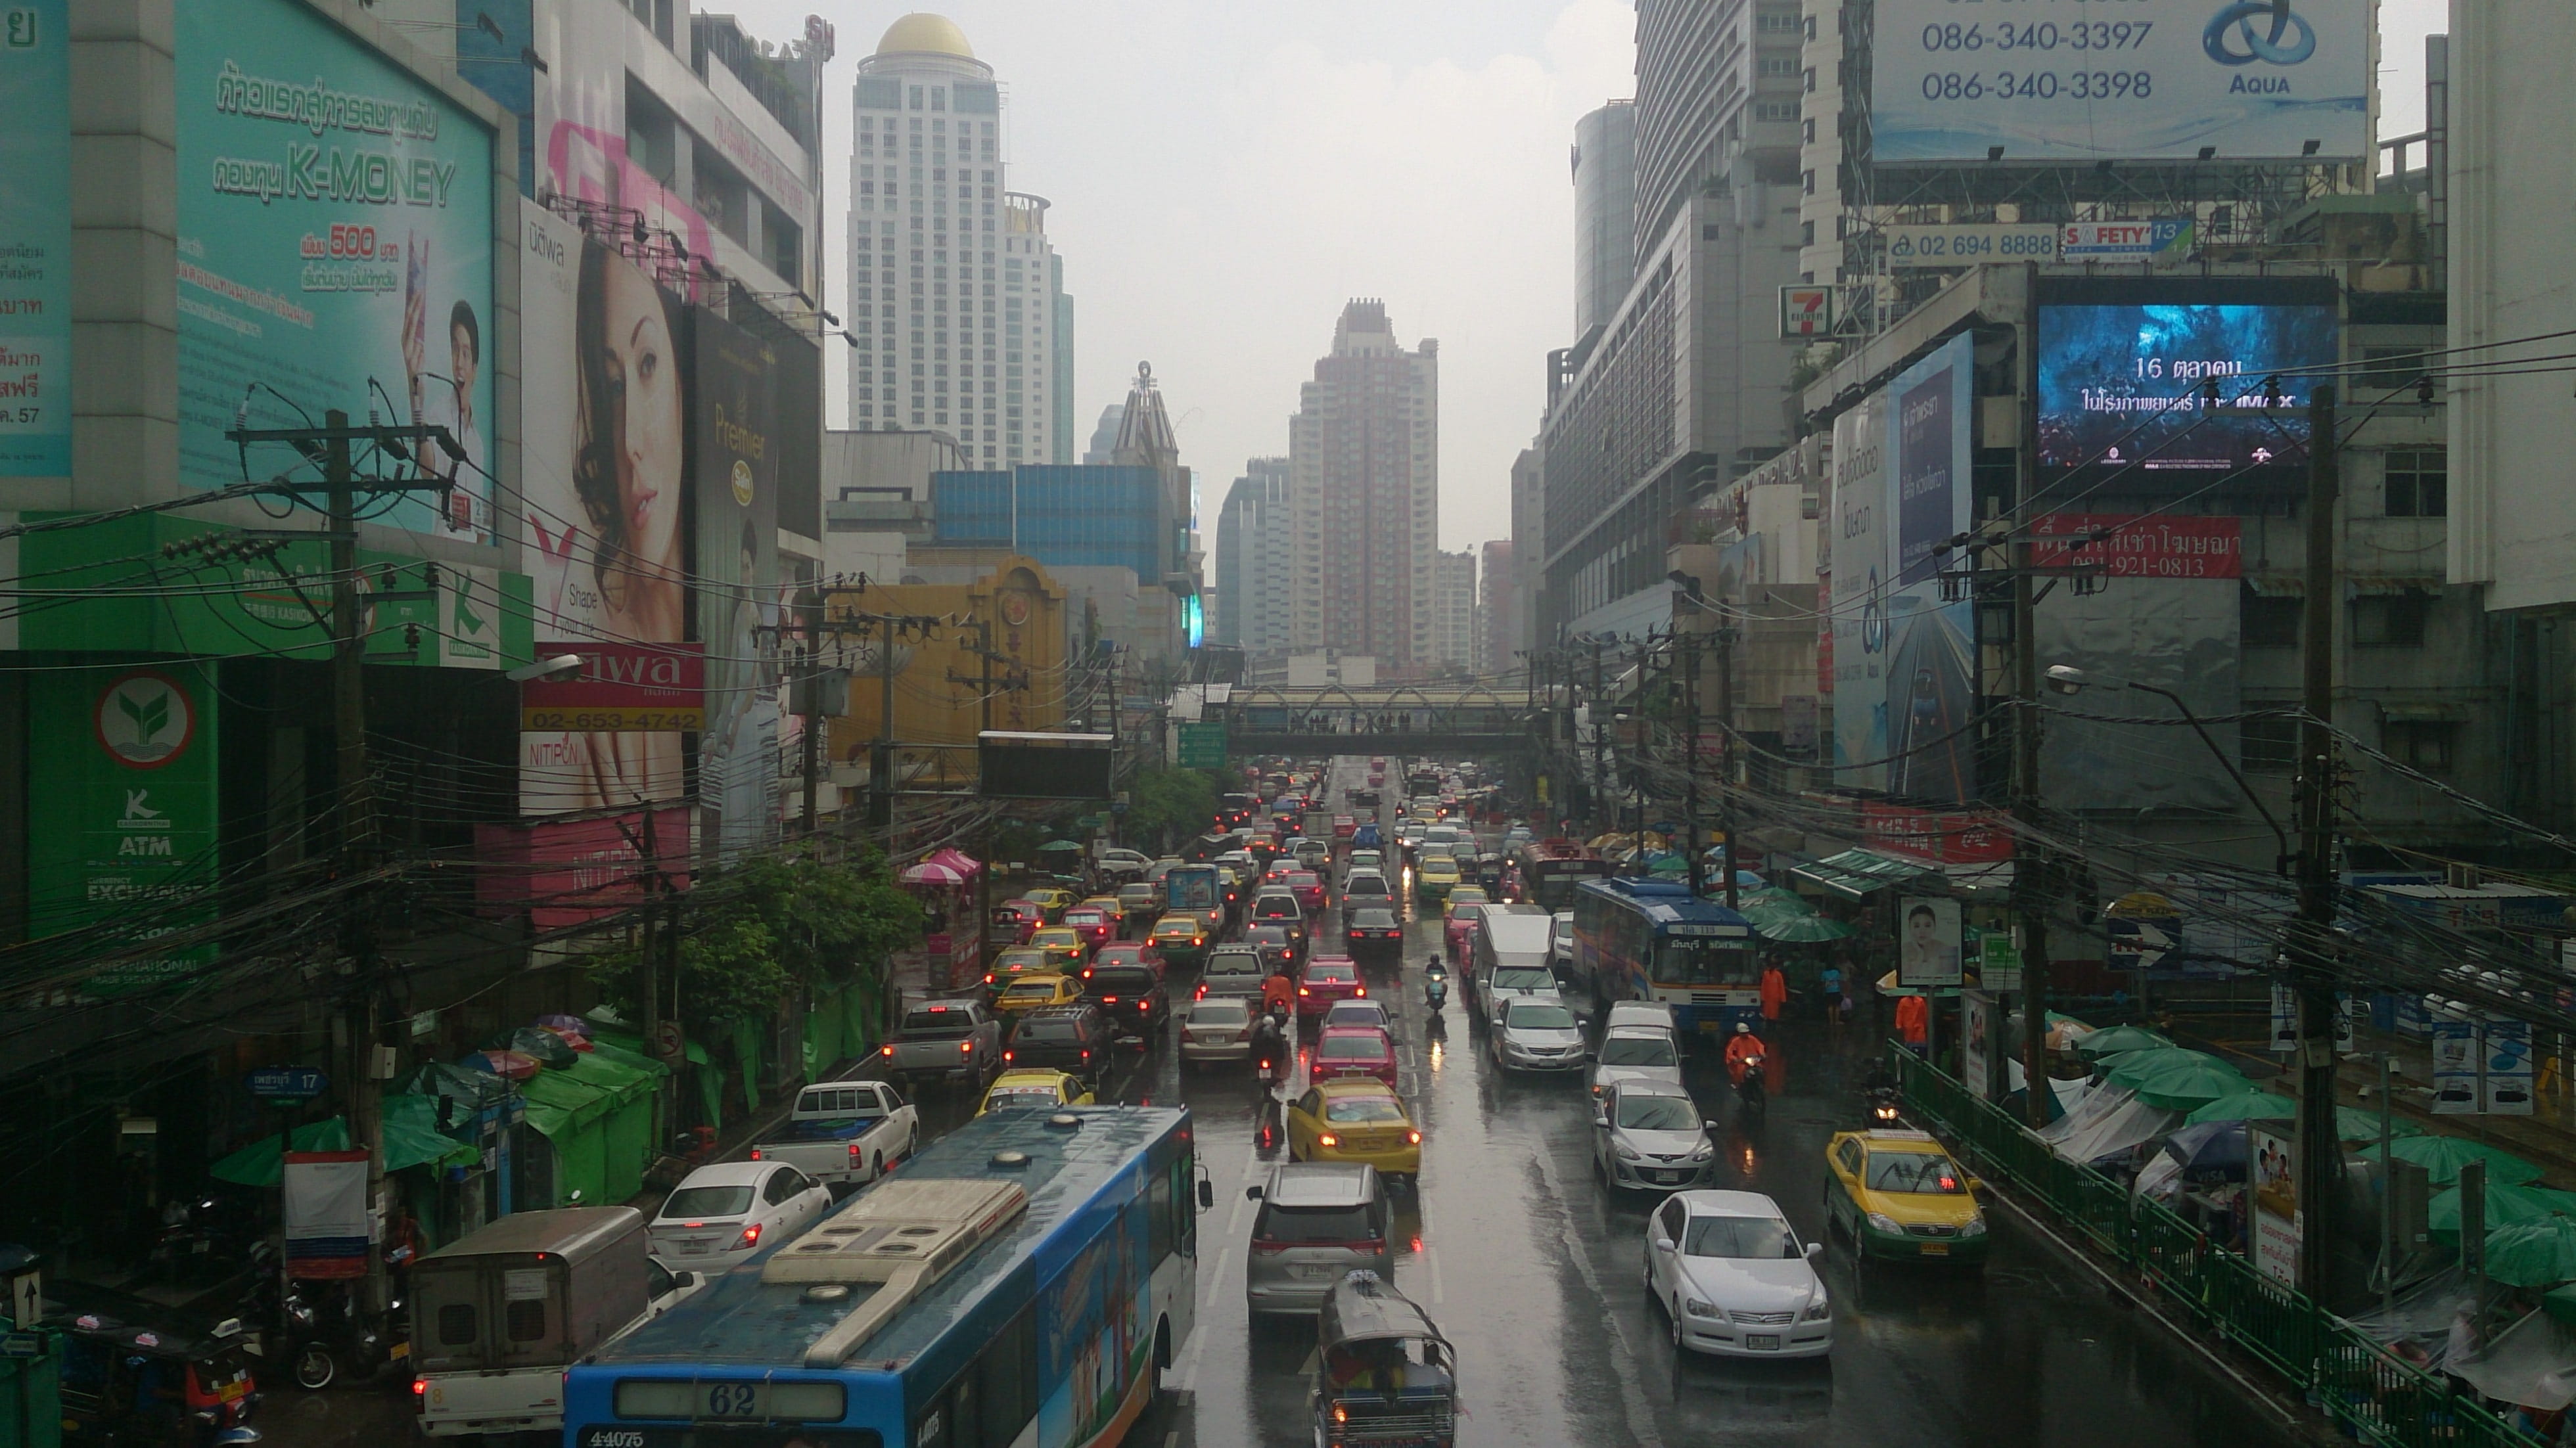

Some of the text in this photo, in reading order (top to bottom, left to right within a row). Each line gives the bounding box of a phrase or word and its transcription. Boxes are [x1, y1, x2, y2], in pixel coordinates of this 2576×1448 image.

[1922, 22, 2154, 52] 086-340-3397
[1922, 72, 2153, 101] 086-340-3398
[214, 143, 455, 207] กองทุน K-MONEY
[329, 224, 376, 260] 500
[1920, 235, 2052, 256] 02 694 8888
[2137, 357, 2242, 386] 16 ตุลาคม
[18, 408, 39, 423] 57
[716, 401, 765, 461] Premier
[570, 583, 597, 612] Shape
[533, 713, 698, 729] 02-653-4742
[118, 836, 172, 856] ATM
[302, 1074, 317, 1089] 17
[2196, 1171, 2226, 1182] VISA
[709, 1384, 756, 1417] 62
